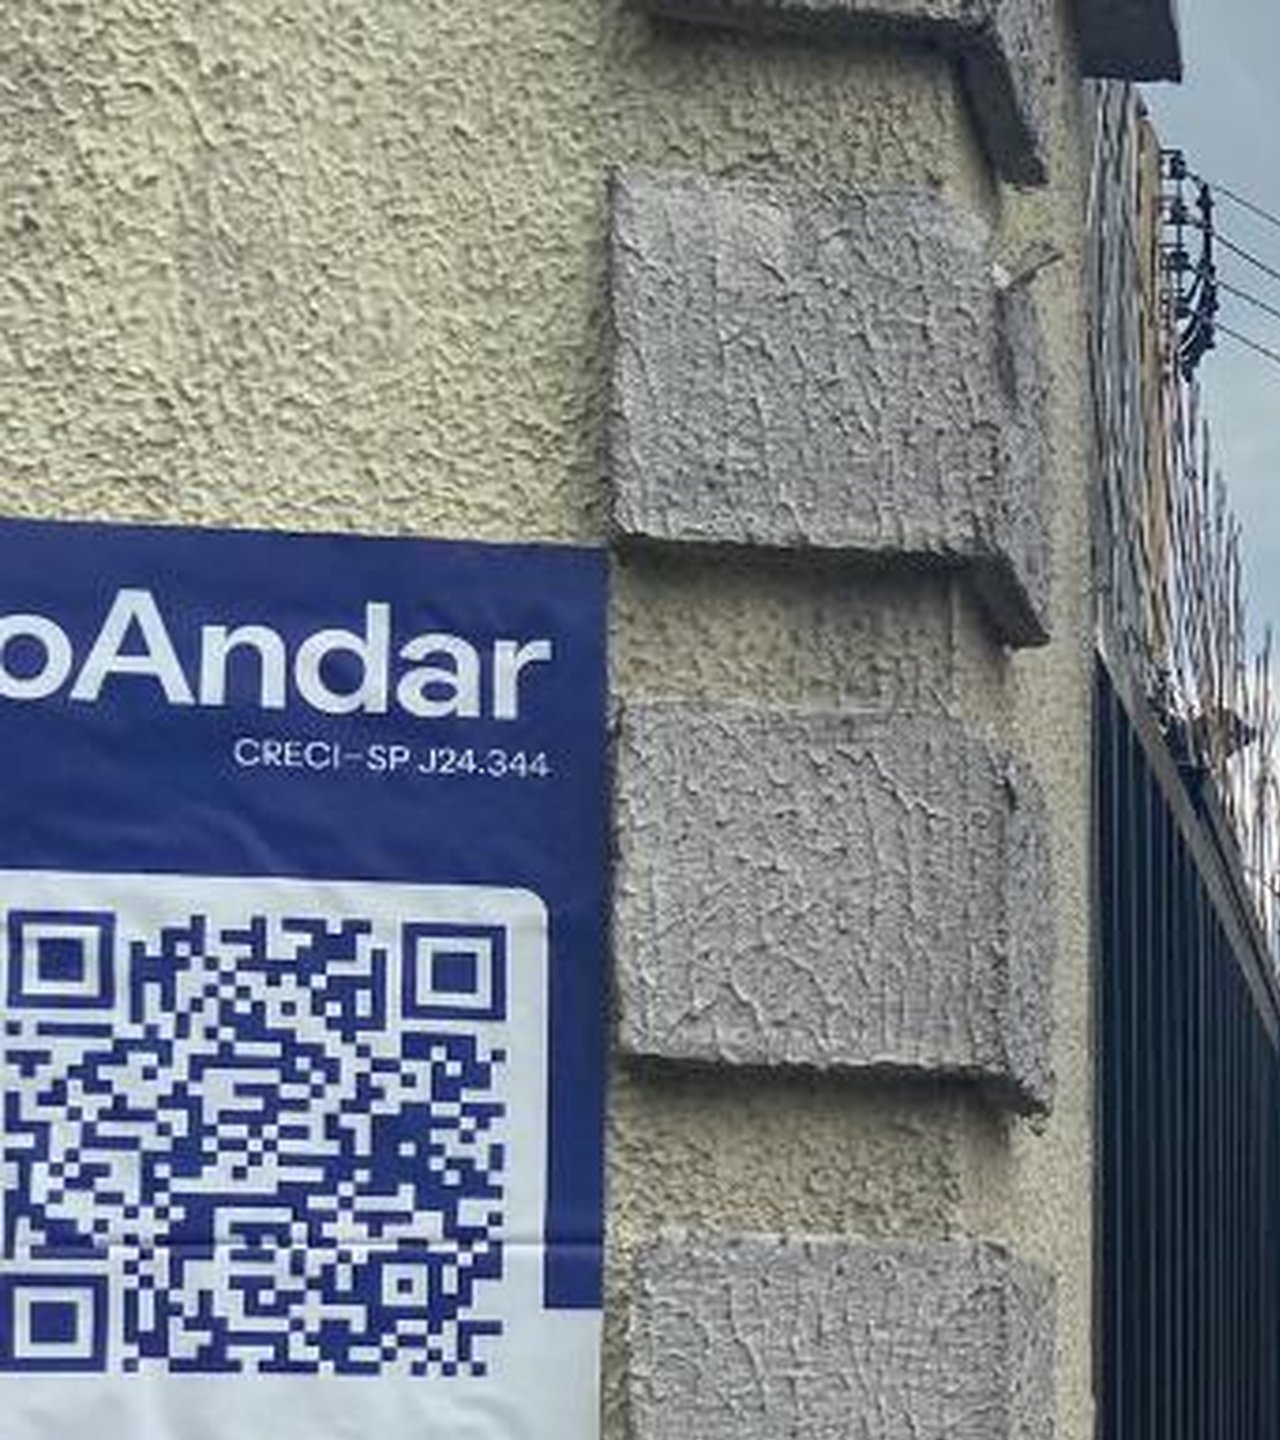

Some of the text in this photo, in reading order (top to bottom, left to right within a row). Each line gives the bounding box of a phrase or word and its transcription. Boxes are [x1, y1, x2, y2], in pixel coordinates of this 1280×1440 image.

[0, 588, 552, 720] oAndar
[234, 738, 551, 777] CRECI-SP J24.344
